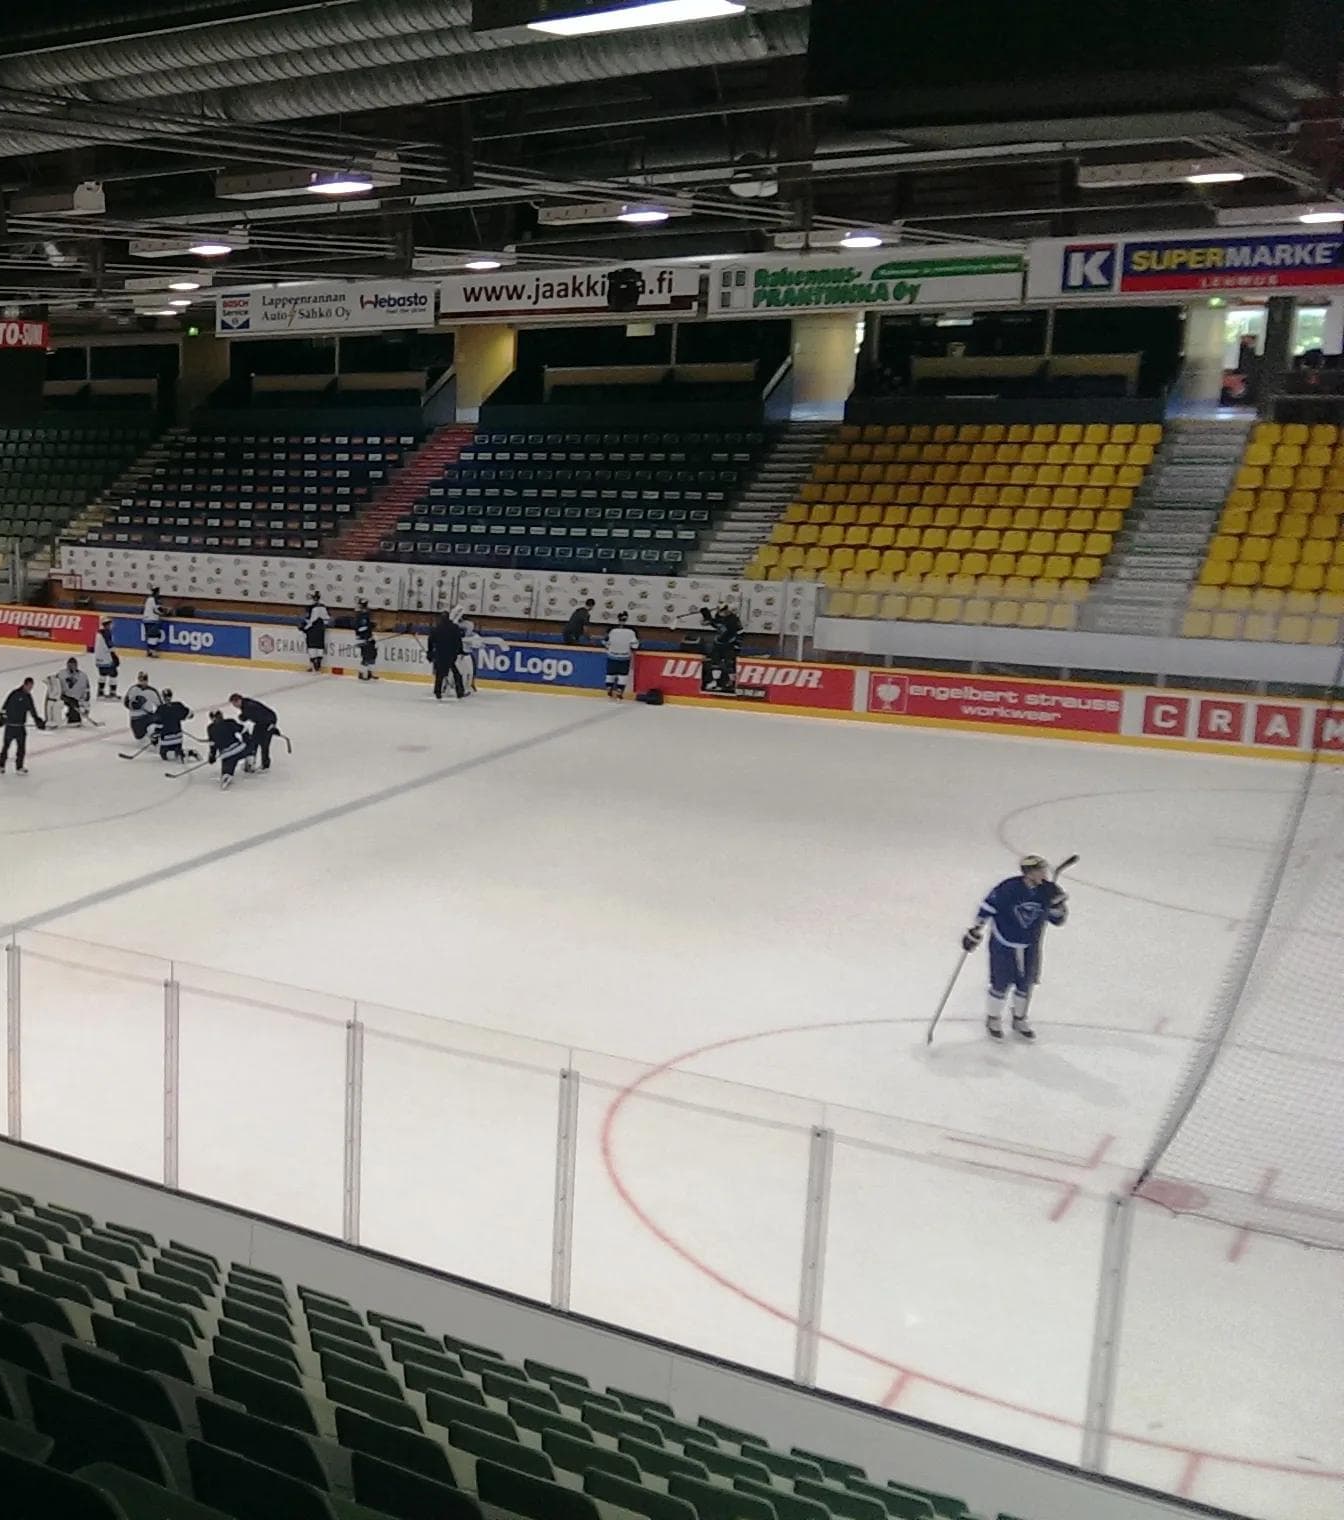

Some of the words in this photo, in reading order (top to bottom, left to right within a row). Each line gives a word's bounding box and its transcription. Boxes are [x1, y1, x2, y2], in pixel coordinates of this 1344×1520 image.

[262, 293, 346, 310] Lappeenrannan
[359, 293, 428, 310] Webasto
[893, 281, 922, 304] Oy
[335, 306, 352, 321] Oy
[169, 625, 214, 651] Logo
[384, 647, 425, 664] LEAGUE
[478, 650, 510, 671] No
[515, 652, 573, 680] Logo
[909, 685, 1018, 703] engelbert
[1024, 694, 1120, 712] strauss
[960, 704, 1061, 722] workwear
